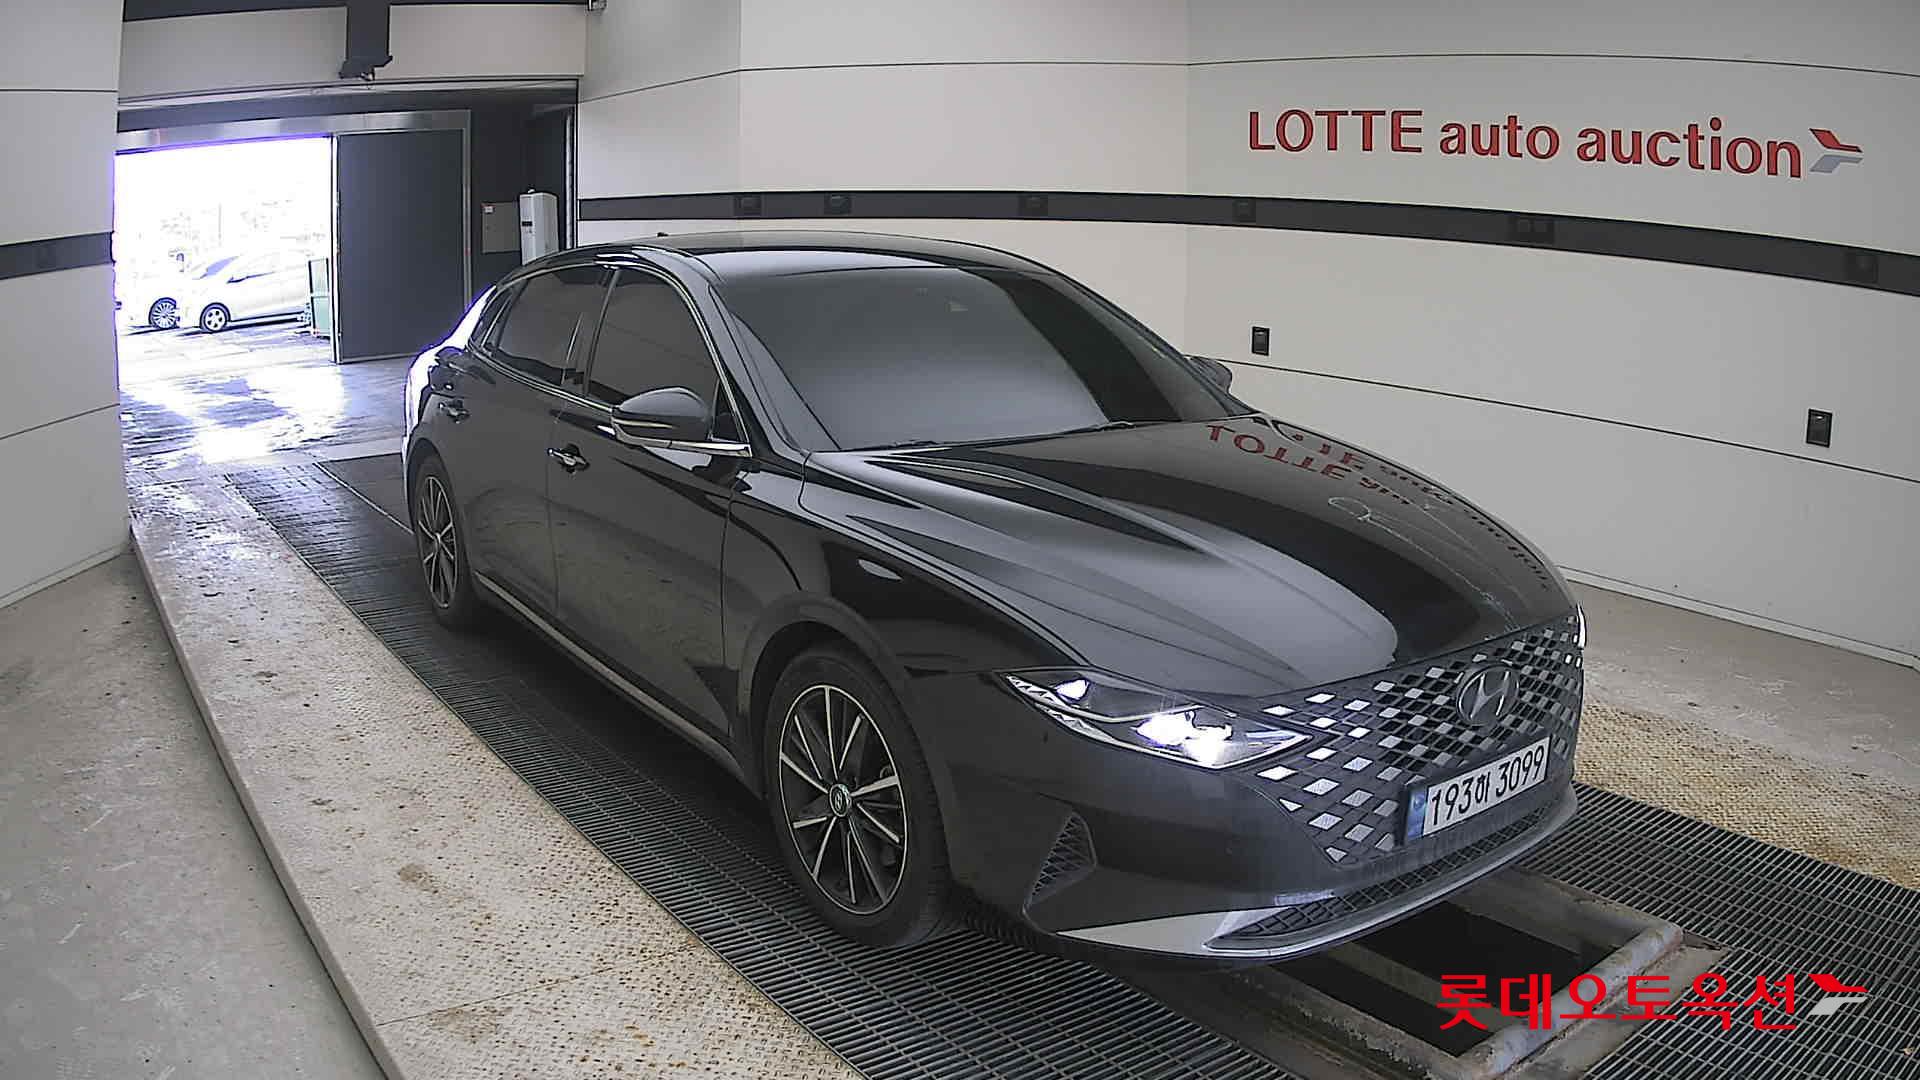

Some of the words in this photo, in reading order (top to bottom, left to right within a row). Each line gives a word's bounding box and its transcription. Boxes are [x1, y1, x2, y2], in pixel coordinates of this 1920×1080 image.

[1249, 110, 1423, 153] LOTTE
[1439, 115, 1560, 160] auto
[1576, 116, 1802, 179] auction
[1496, 745, 1545, 798] 3099
